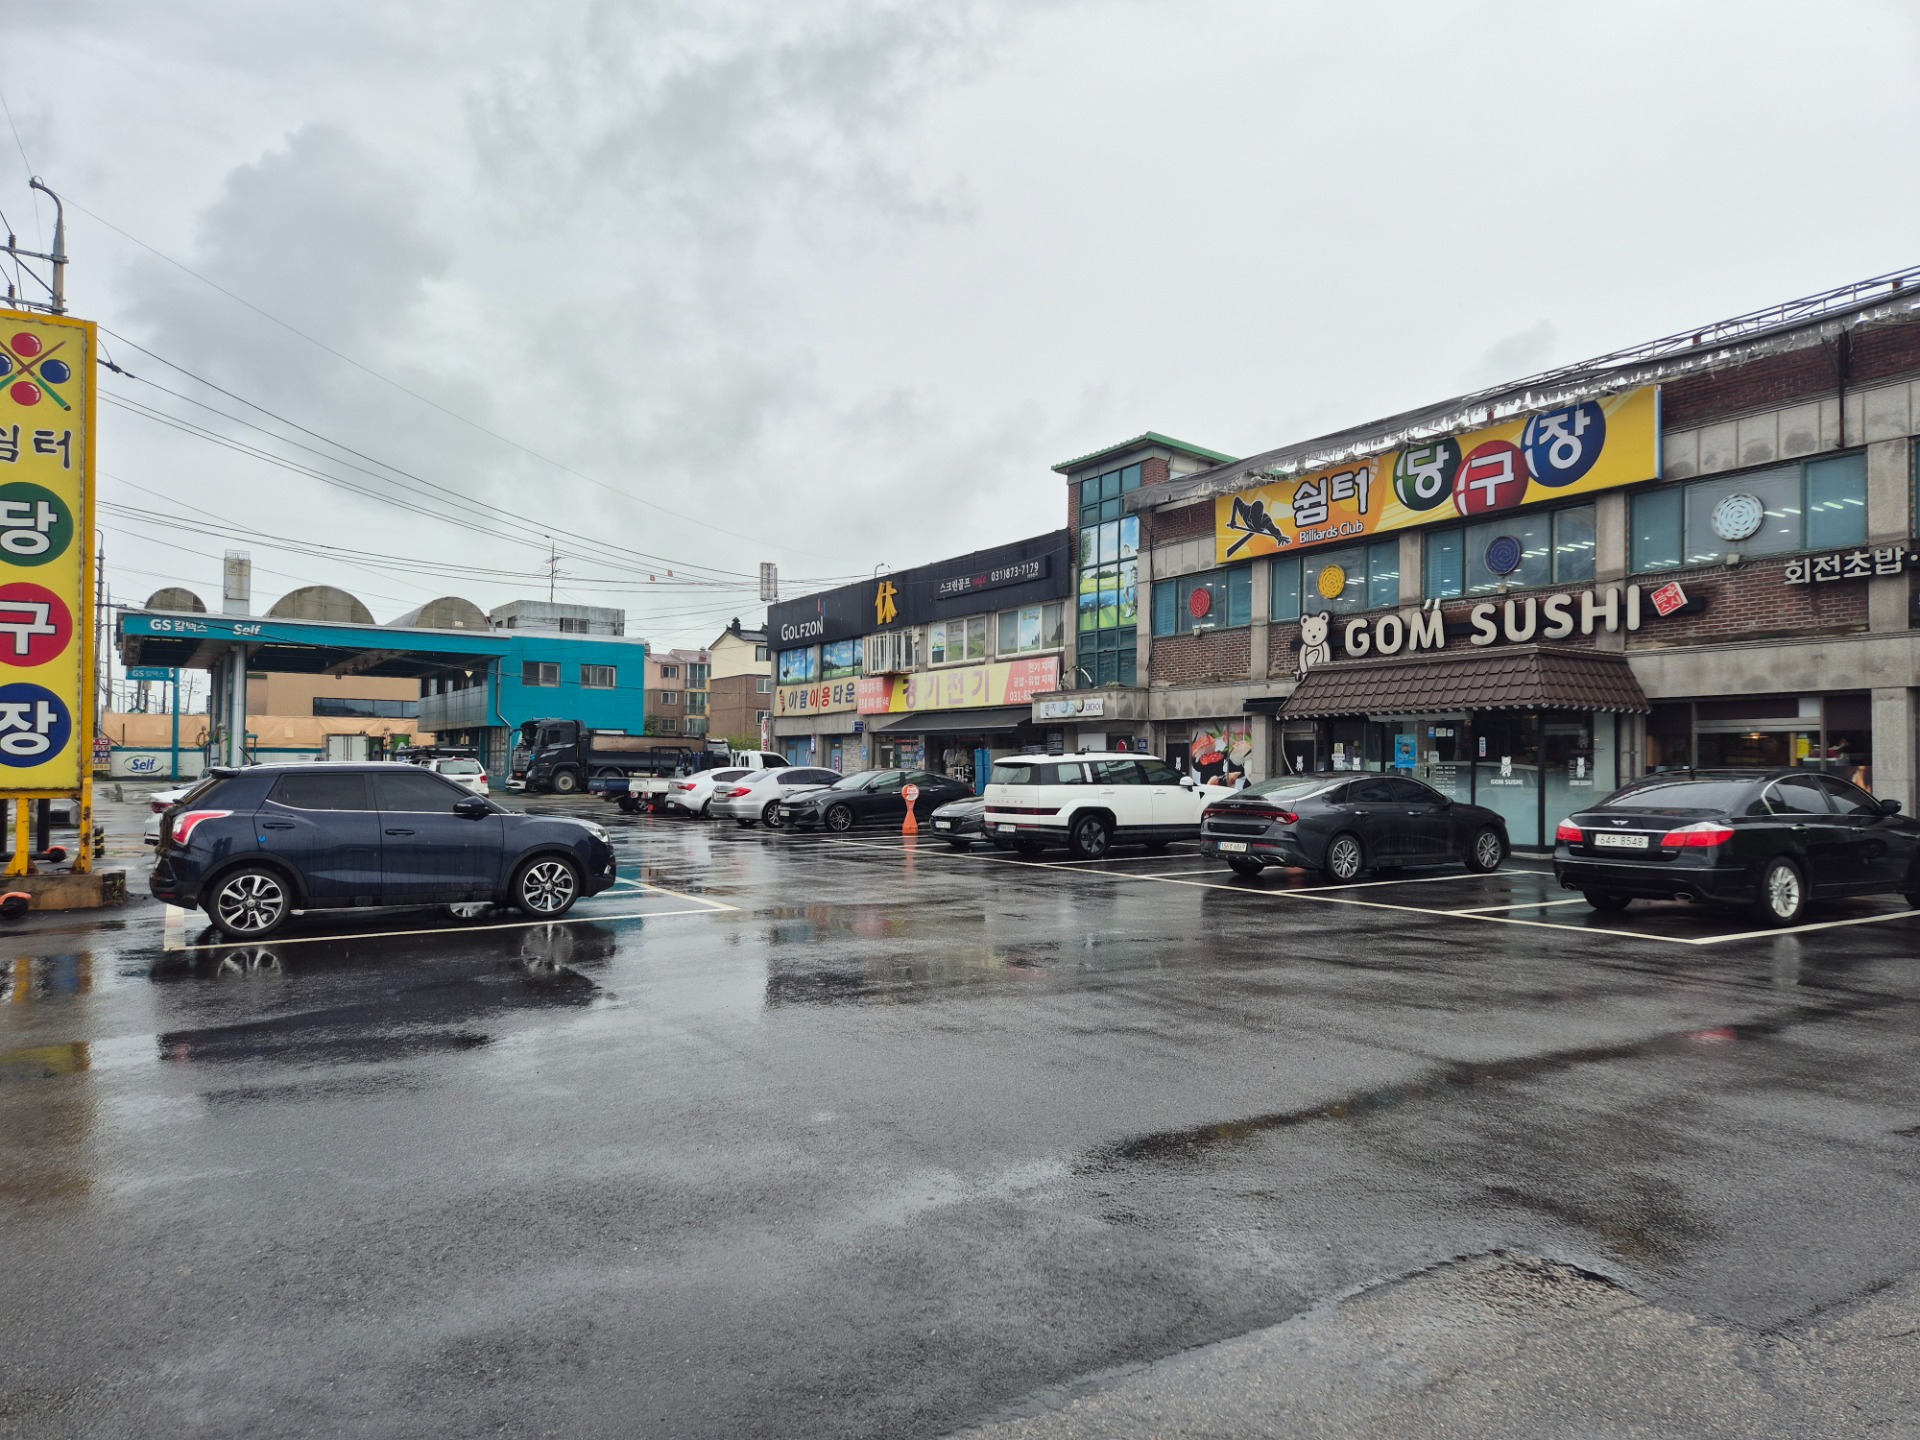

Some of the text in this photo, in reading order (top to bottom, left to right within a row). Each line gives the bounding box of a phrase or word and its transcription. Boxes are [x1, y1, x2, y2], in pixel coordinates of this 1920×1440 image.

[1293, 408, 1591, 529] 쉼터 당구장
[1299, 519, 1364, 545] Billiards Club
[940, 577, 971, 593] 스크린골프
[991, 561, 1039, 581] 031)873-7179
[875, 580, 898, 625] 休
[150, 619, 262, 636] GS 칼텍스 Self
[781, 615, 824, 641] GOLFZON
[1345, 585, 1640, 657] GOM SUSHI
[132, 669, 144, 677] GS
[902, 669, 990, 710] 경기전기
[131, 758, 156, 771] Self
